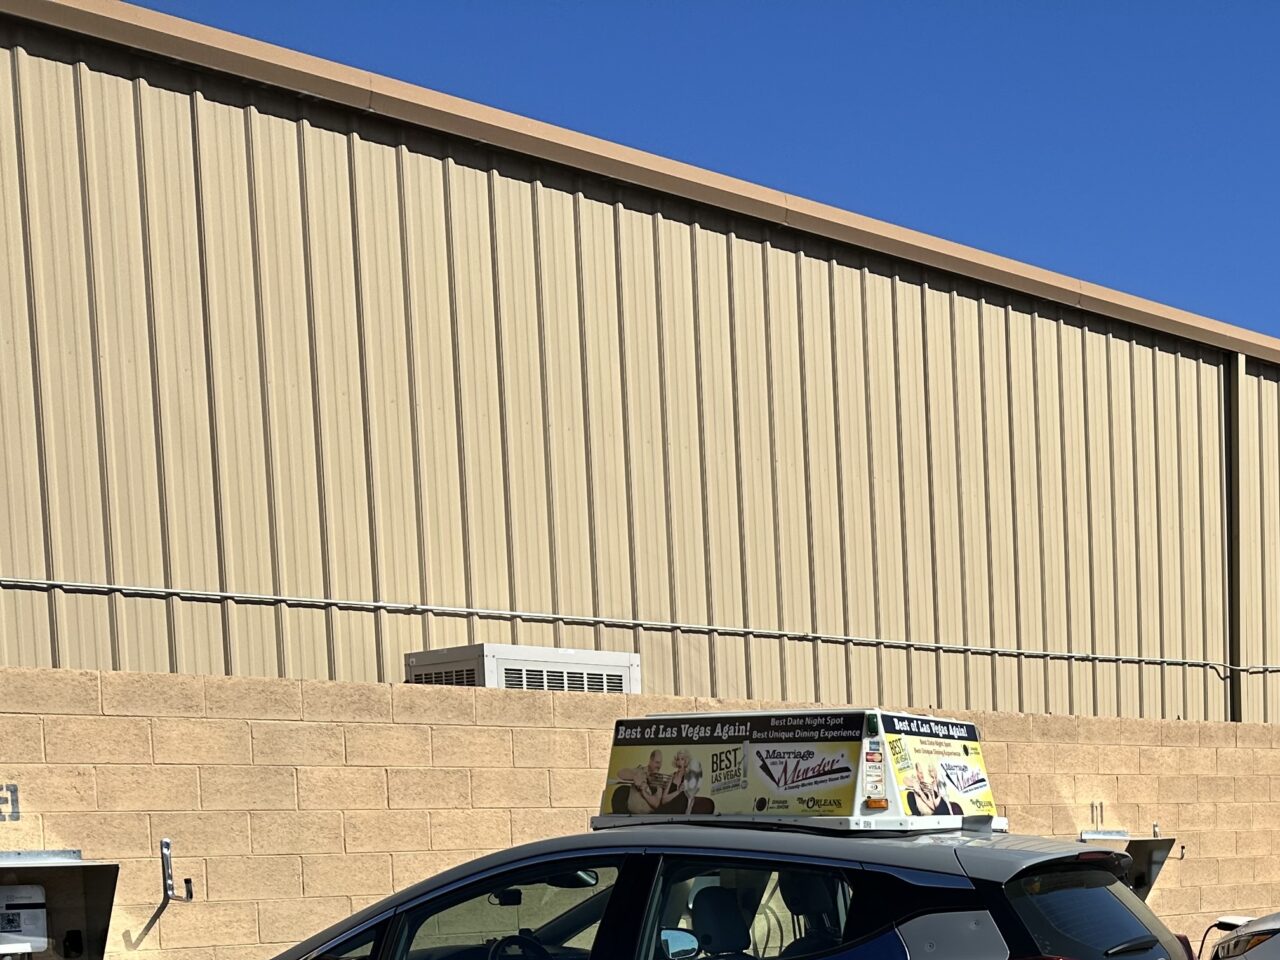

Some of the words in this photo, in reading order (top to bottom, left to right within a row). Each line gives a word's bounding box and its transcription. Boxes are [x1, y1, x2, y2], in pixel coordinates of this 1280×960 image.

[771, 717, 787, 726] Best
[788, 717, 803, 725] Date
[805, 716, 825, 727] Night
[827, 716, 844, 726] Spot
[893, 718, 906, 731] Best
[910, 719, 919, 732] of
[919, 720, 930, 733] Las
[931, 722, 949, 737] Vegas
[949, 724, 968, 738] Again!
[618, 726, 641, 739] Best
[645, 724, 656, 737] of
[659, 725, 678, 737] Las
[681, 724, 711, 740] Vegas
[714, 722, 751, 739] Again!
[752, 730, 768, 739] Best
[769, 730, 794, 740] Unique
[795, 729, 819, 739] Dining
[820, 728, 860, 738] Experience
[712, 748, 739, 773] BEST
[765, 750, 815, 761] Marriage
[712, 773, 723, 784] LAS
[723, 768, 742, 780] VEGAS
[777, 757, 840, 787] Murder
